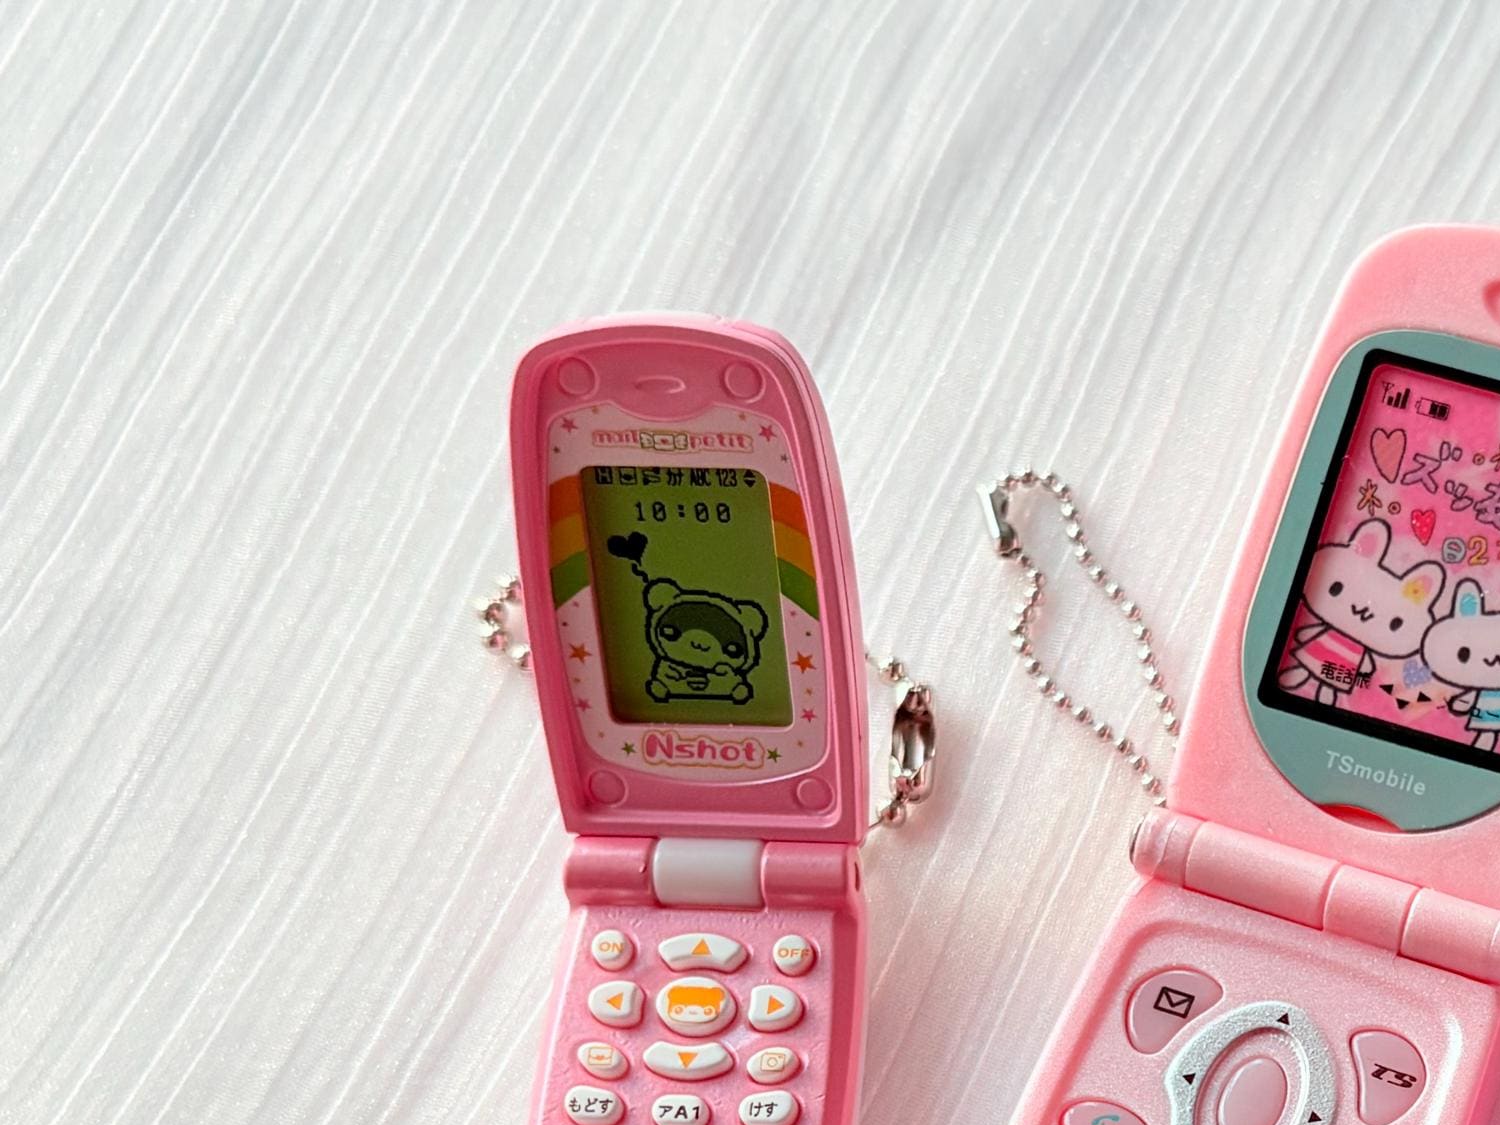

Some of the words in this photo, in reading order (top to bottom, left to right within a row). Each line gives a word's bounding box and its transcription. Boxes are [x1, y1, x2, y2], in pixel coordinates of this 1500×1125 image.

[635, 501, 731, 523] 10:00
[645, 732, 756, 763] Nshot
[1325, 750, 1427, 797] TSmobile
[599, 941, 625, 954] ON
[777, 947, 811, 959] OFF
[568, 1097, 613, 1113] もどす
[749, 1102, 779, 1117] けす
